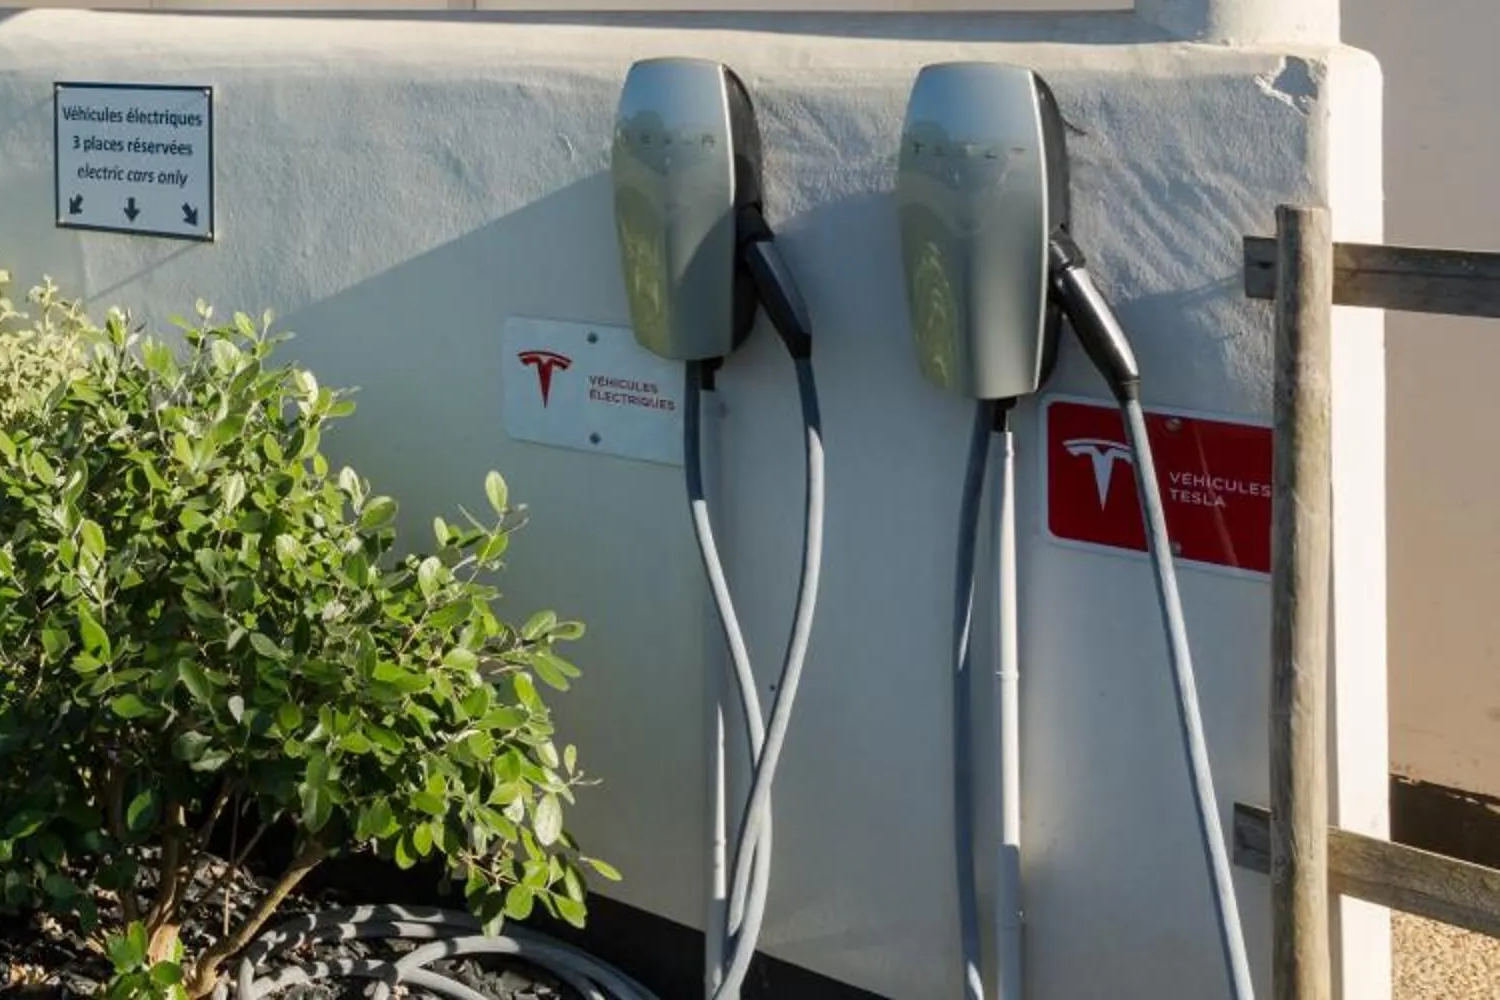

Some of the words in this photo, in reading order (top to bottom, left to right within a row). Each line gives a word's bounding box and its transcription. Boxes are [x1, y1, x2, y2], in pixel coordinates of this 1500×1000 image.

[62, 105, 123, 123] Véhicules
[126, 107, 203, 128] électriques
[72, 135, 81, 149] 3
[83, 135, 124, 153] places
[127, 138, 193, 157] réservées
[77, 162, 124, 182] electric
[127, 170, 153, 184] cars
[158, 169, 189, 189] only
[1169, 487, 1227, 509] TESLA
